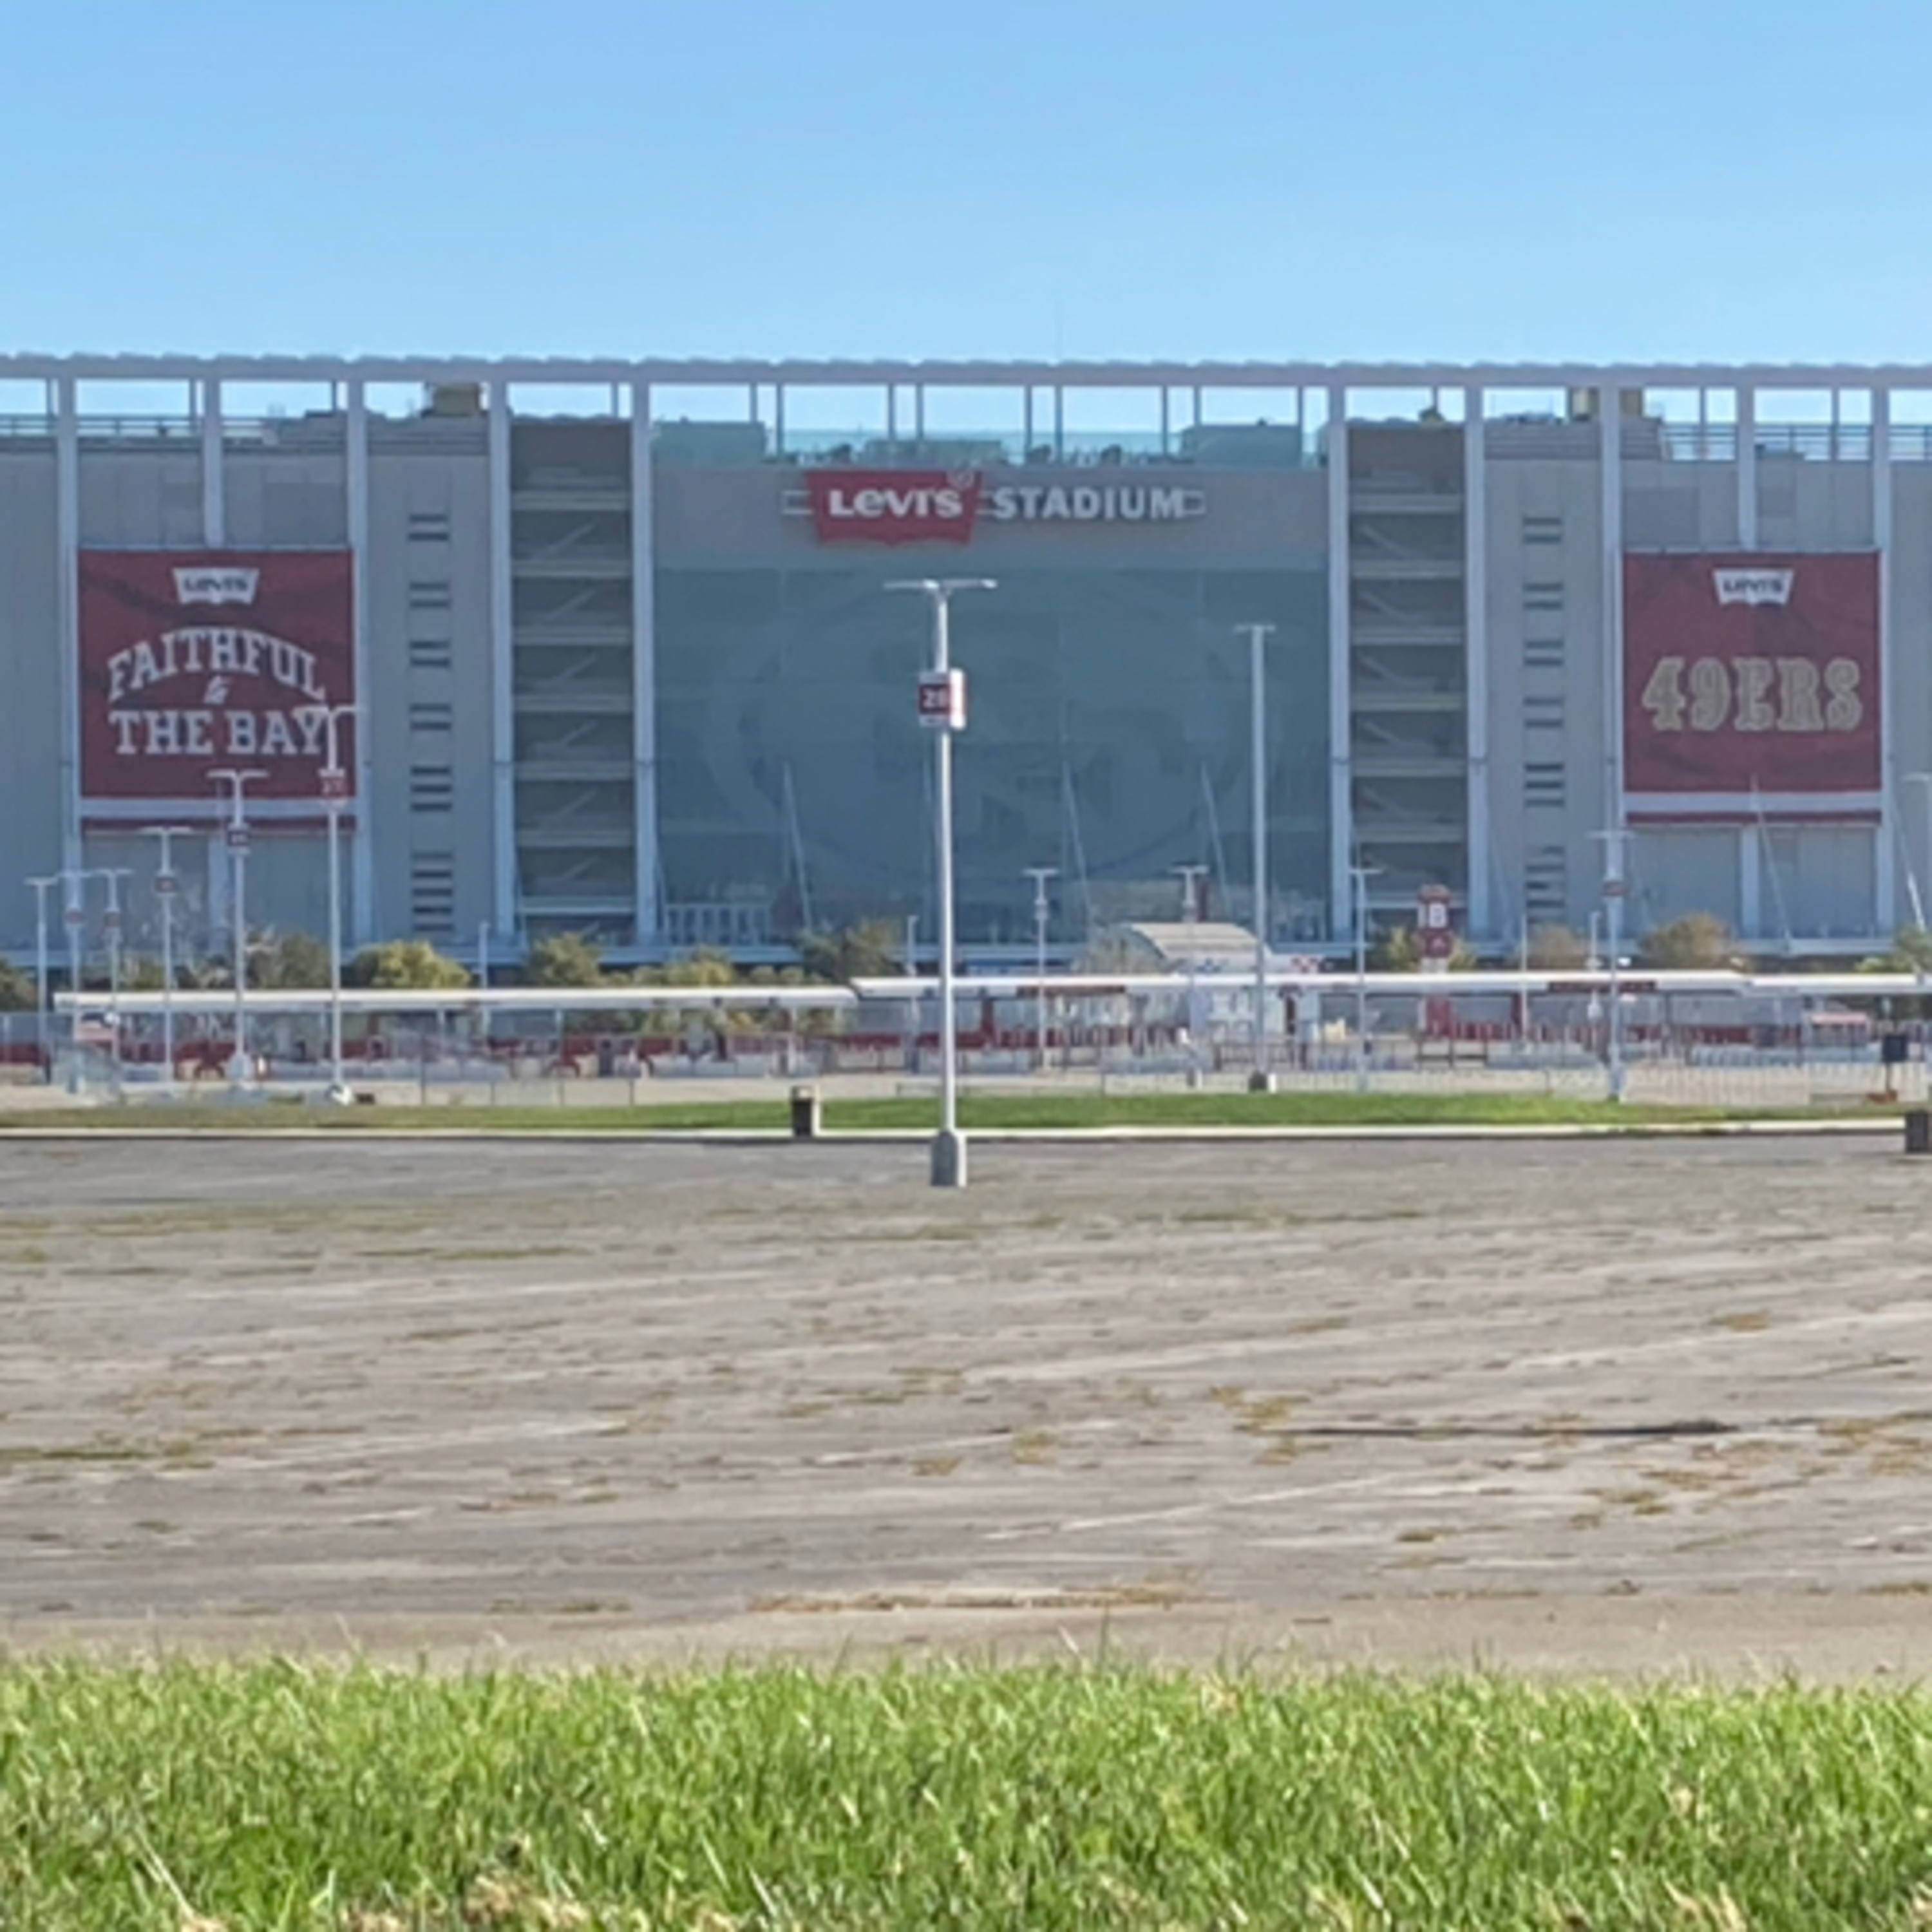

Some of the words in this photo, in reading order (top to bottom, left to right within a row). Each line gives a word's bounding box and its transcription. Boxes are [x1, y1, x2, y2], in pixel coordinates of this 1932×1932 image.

[993, 487, 1183, 519] STADIUM
[107, 627, 325, 703] FAITHFUL
[1641, 656, 1864, 732] 49ERS
[108, 710, 213, 755] THE
[224, 710, 327, 755] BAY
